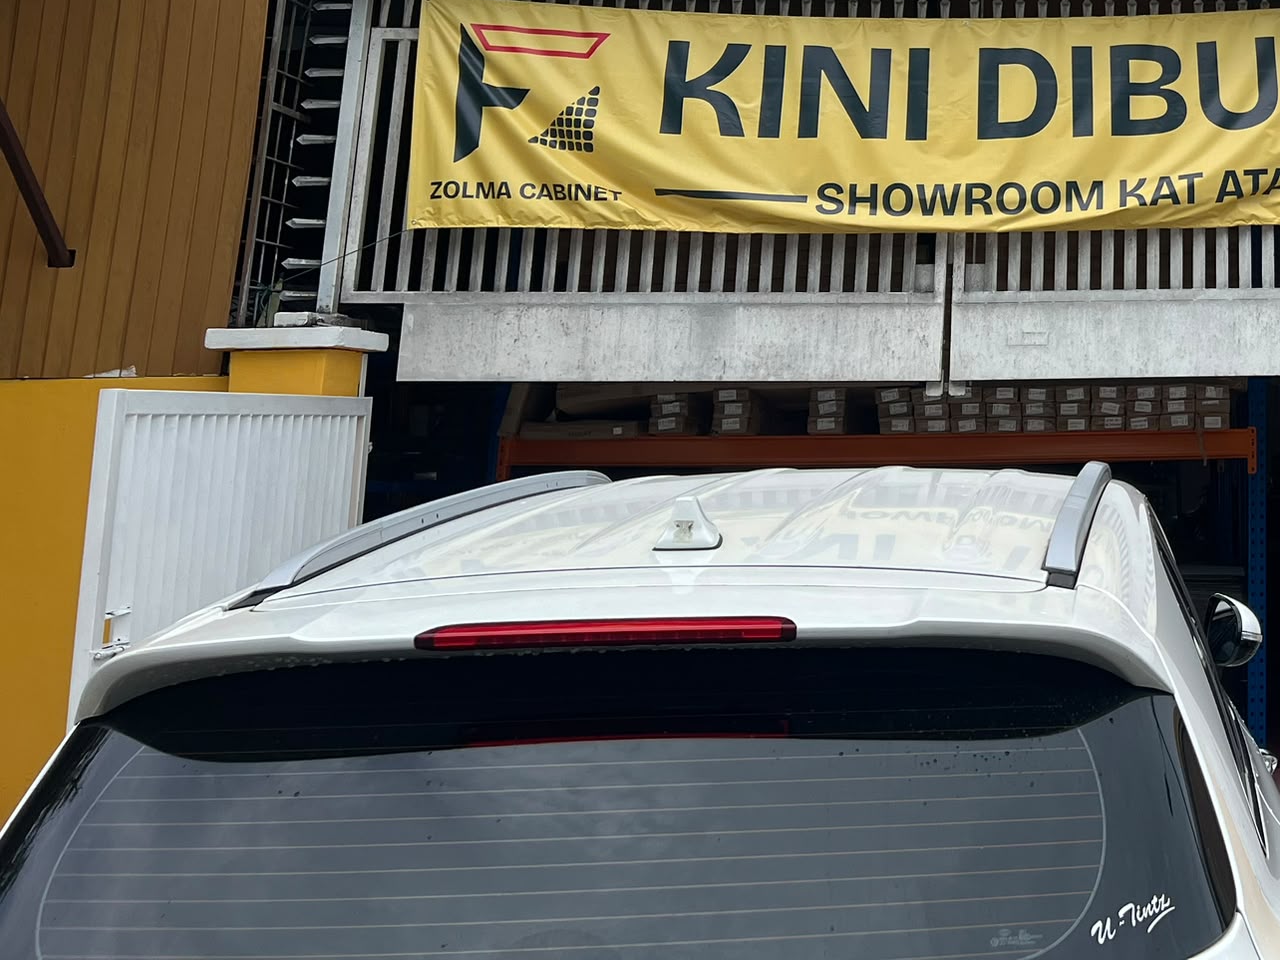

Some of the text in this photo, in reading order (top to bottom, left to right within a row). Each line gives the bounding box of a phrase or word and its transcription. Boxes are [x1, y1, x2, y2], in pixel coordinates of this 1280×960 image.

[659, 39, 931, 141] KINI
[430, 180, 623, 202] ZOLMA CABINET
[815, 179, 1104, 217] SHOWROOM
[1118, 172, 1204, 207] KAT
